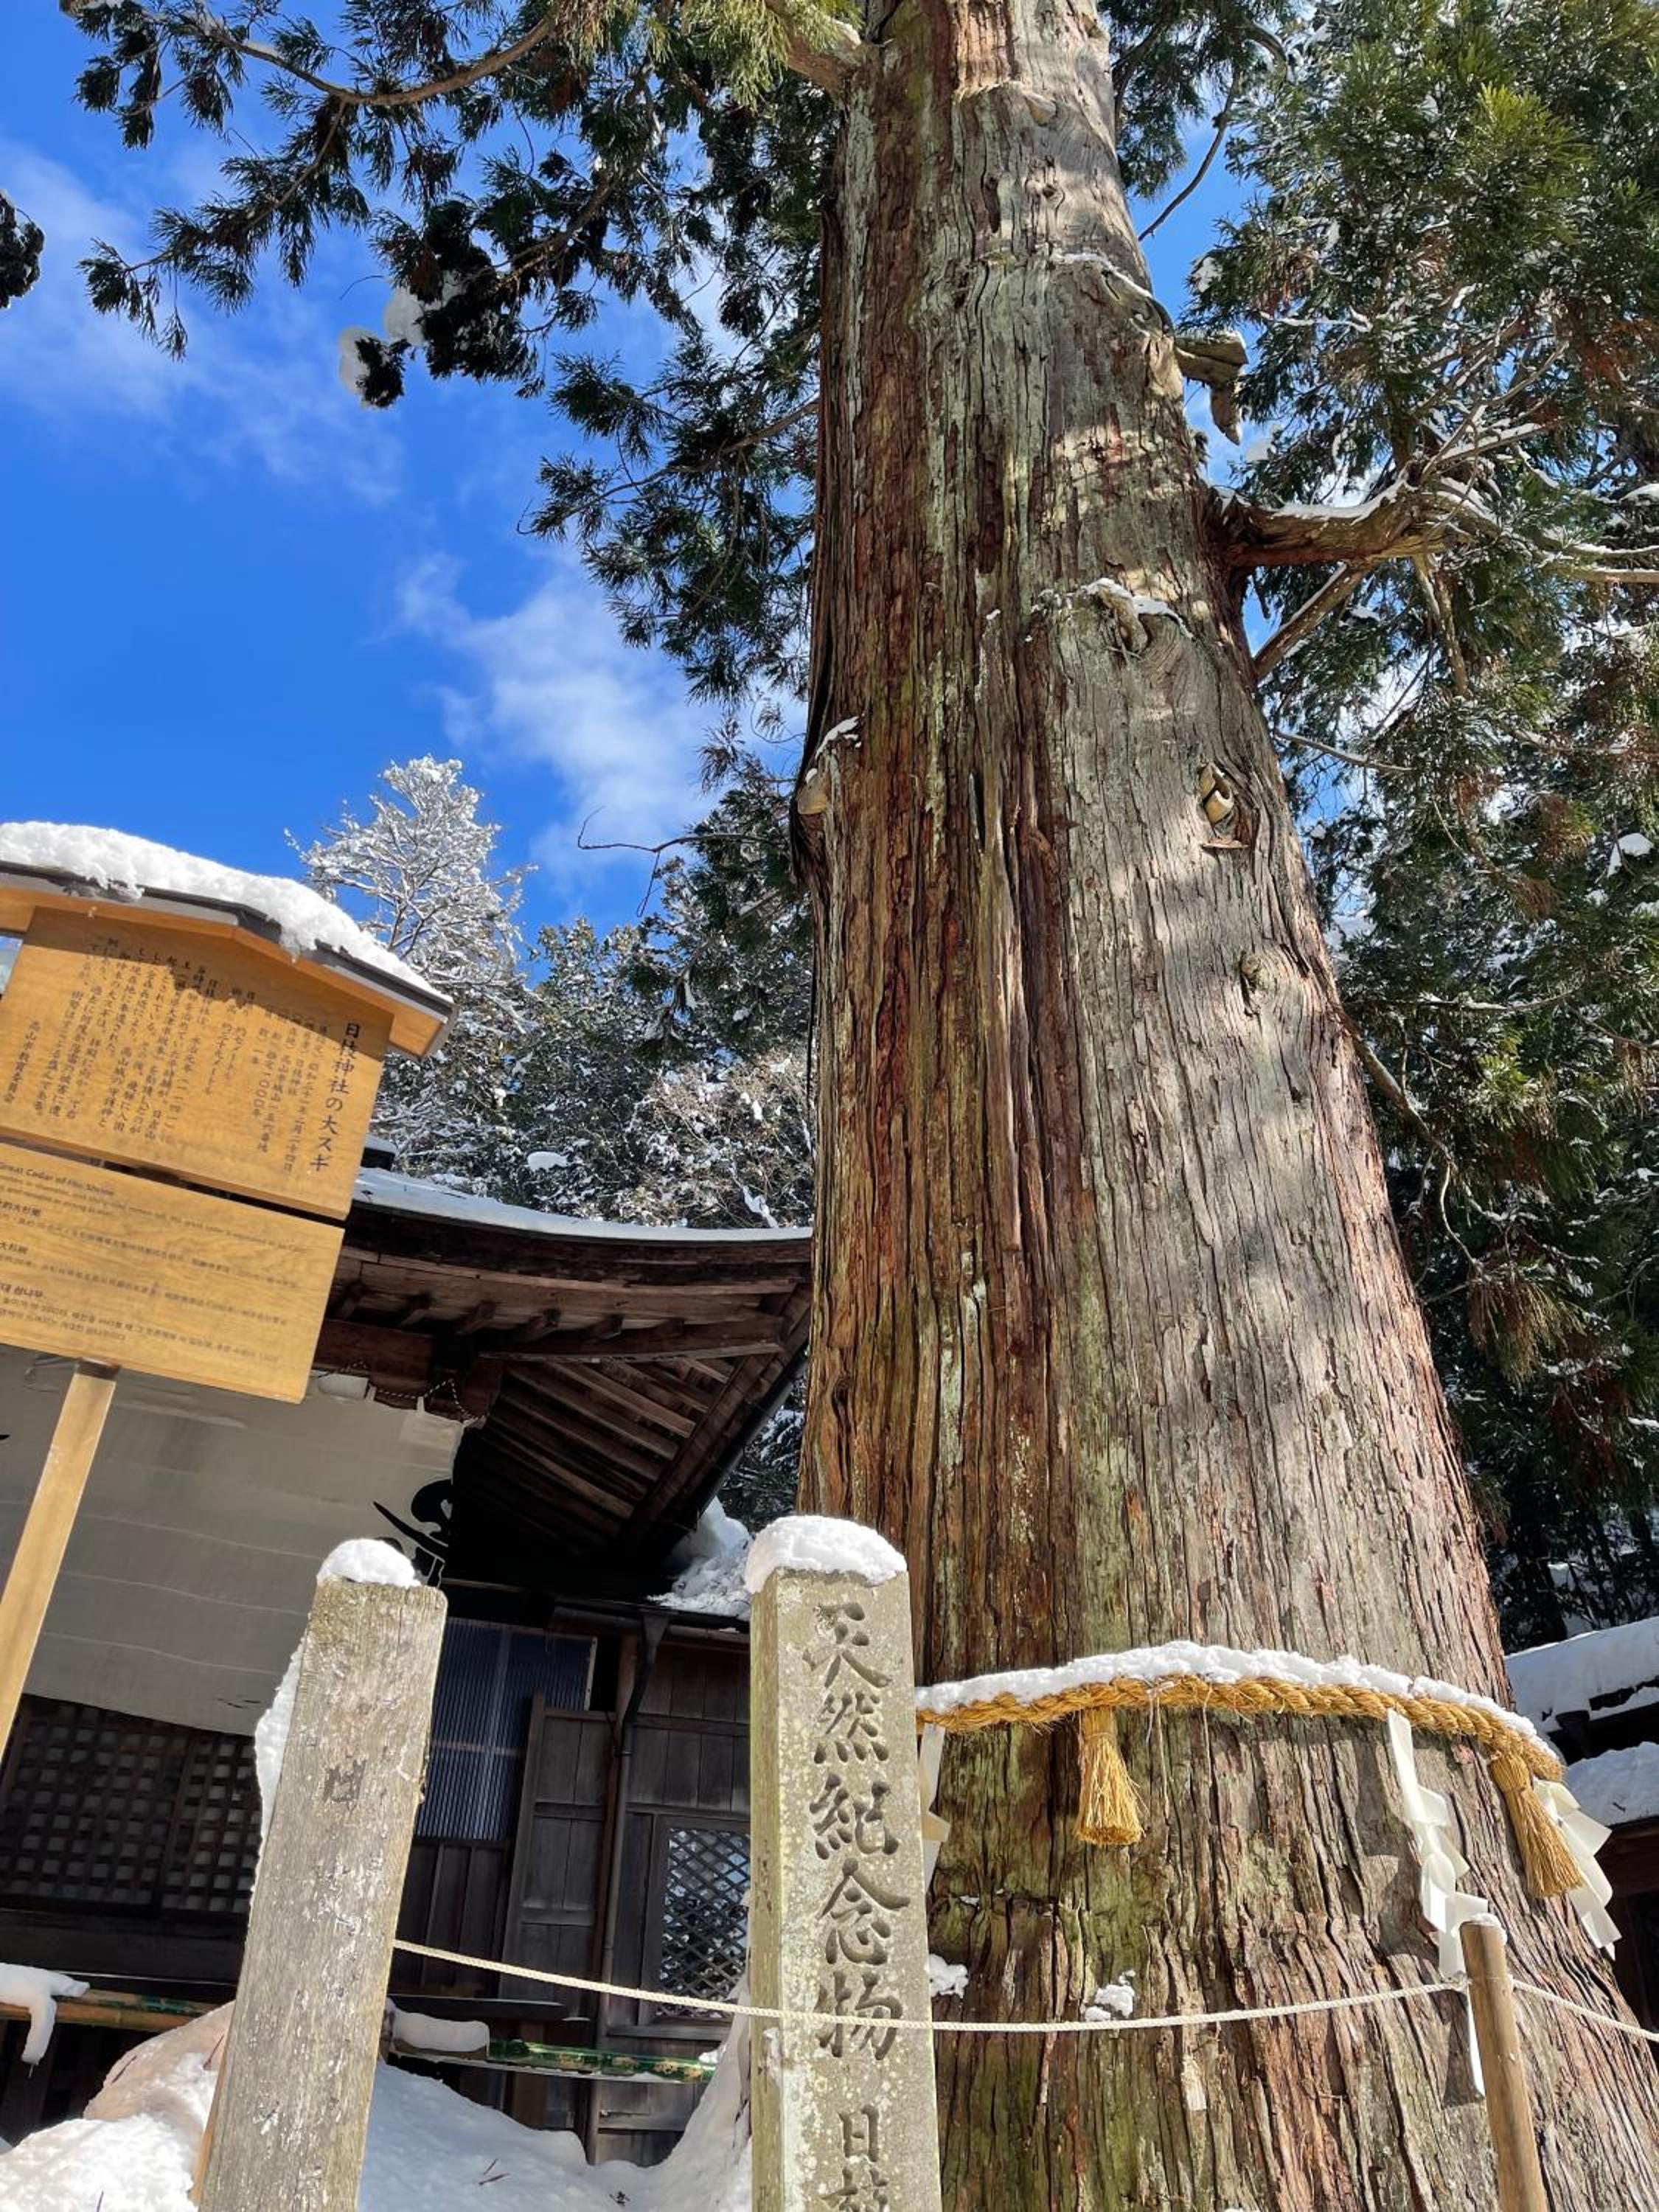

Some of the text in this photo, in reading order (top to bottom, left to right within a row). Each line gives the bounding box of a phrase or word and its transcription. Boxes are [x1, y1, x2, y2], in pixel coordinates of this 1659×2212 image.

[310, 1021, 361, 1172] 日枝神社の大スギ
[801, 1602, 911, 2062] 天然紀念物
